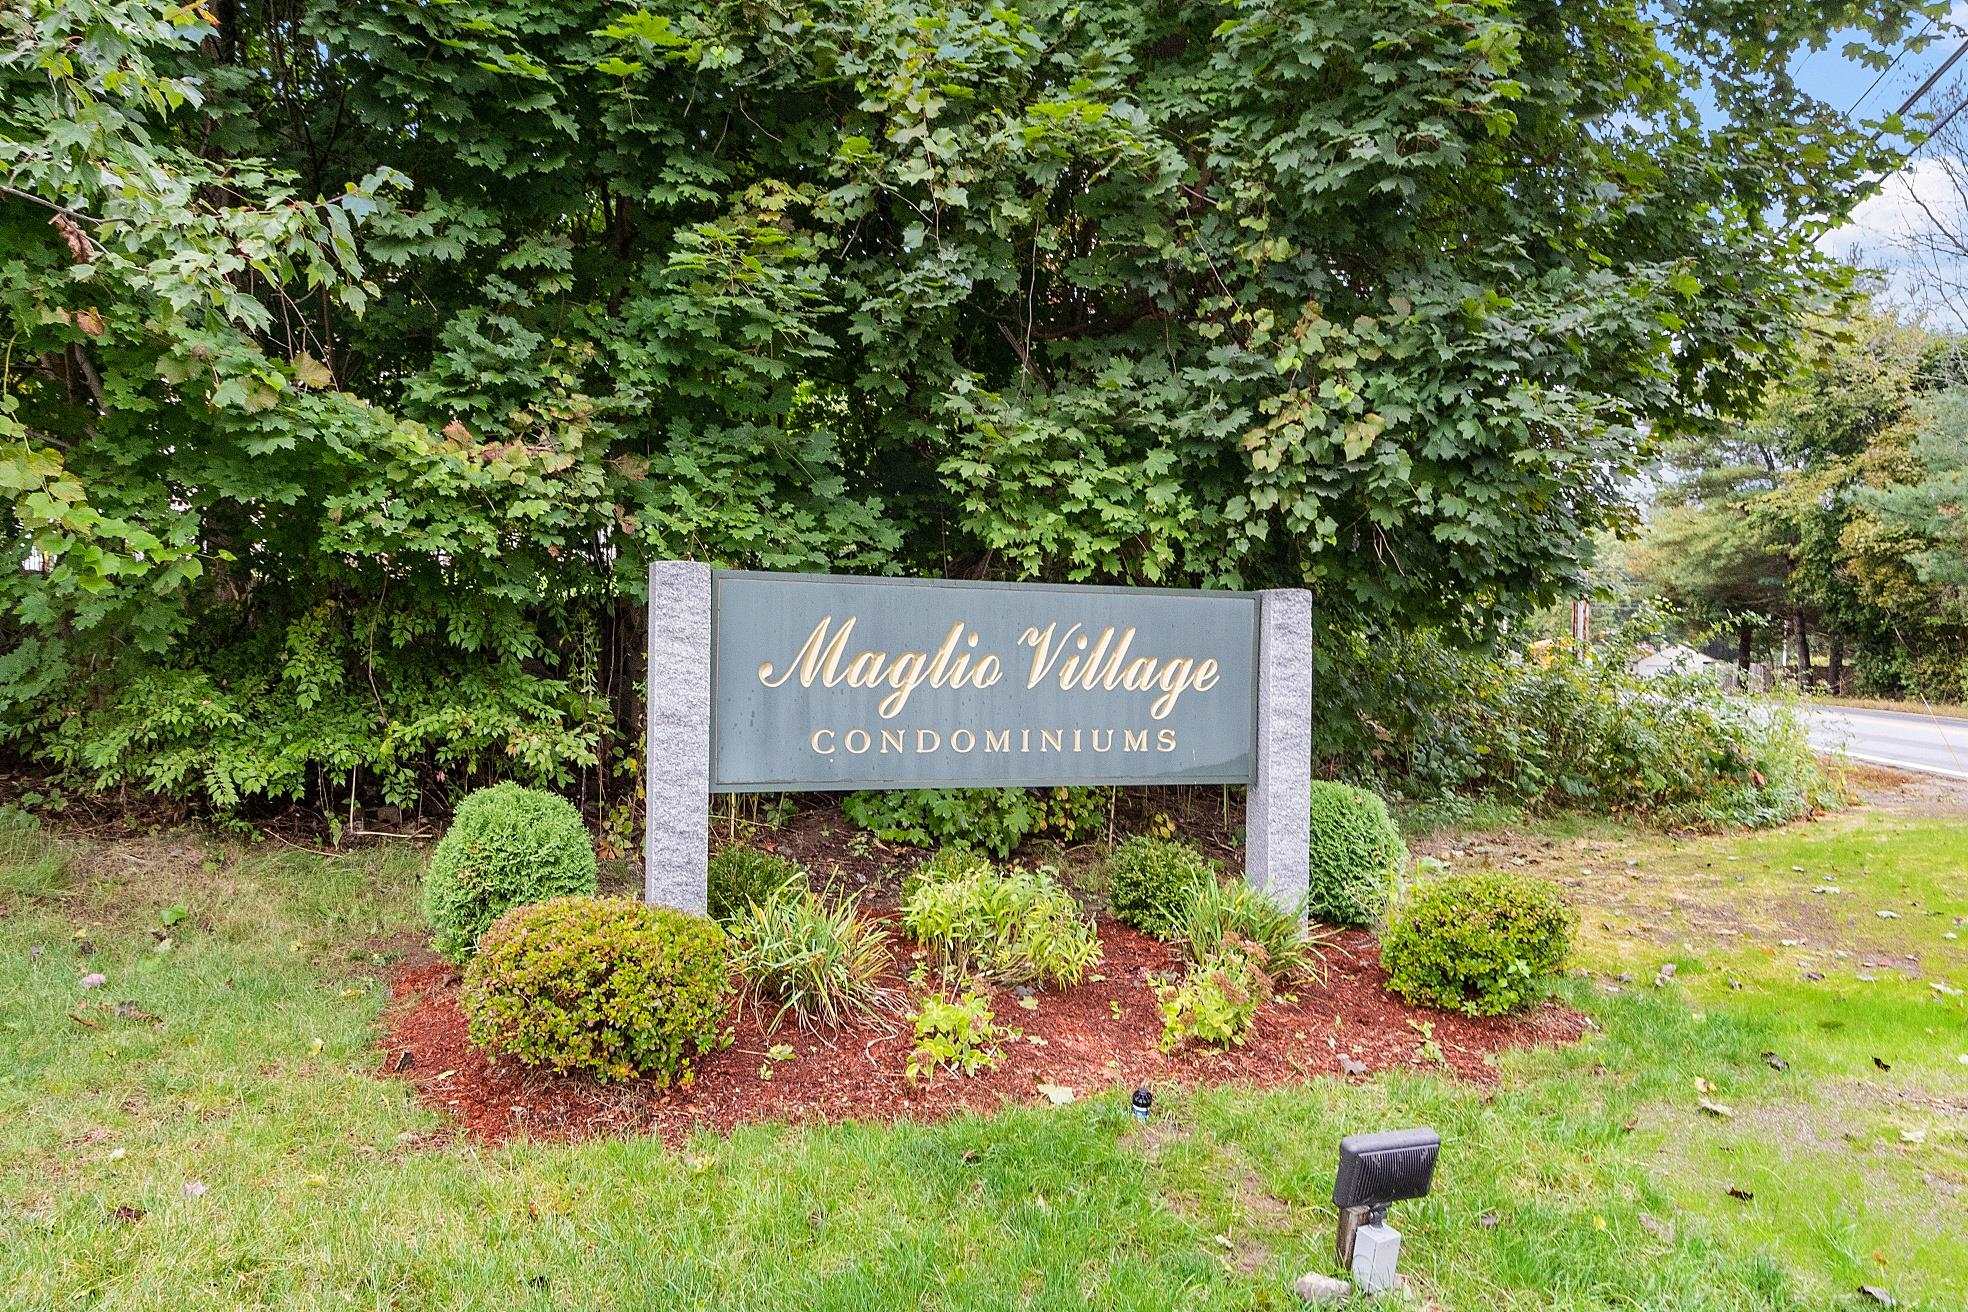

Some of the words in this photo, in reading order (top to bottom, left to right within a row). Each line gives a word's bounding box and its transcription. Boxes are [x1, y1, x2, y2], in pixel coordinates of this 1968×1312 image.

[758, 614, 1003, 719] Maglio
[1017, 621, 1220, 720] Village
[810, 728, 1178, 754] CONDOMINIUMS
